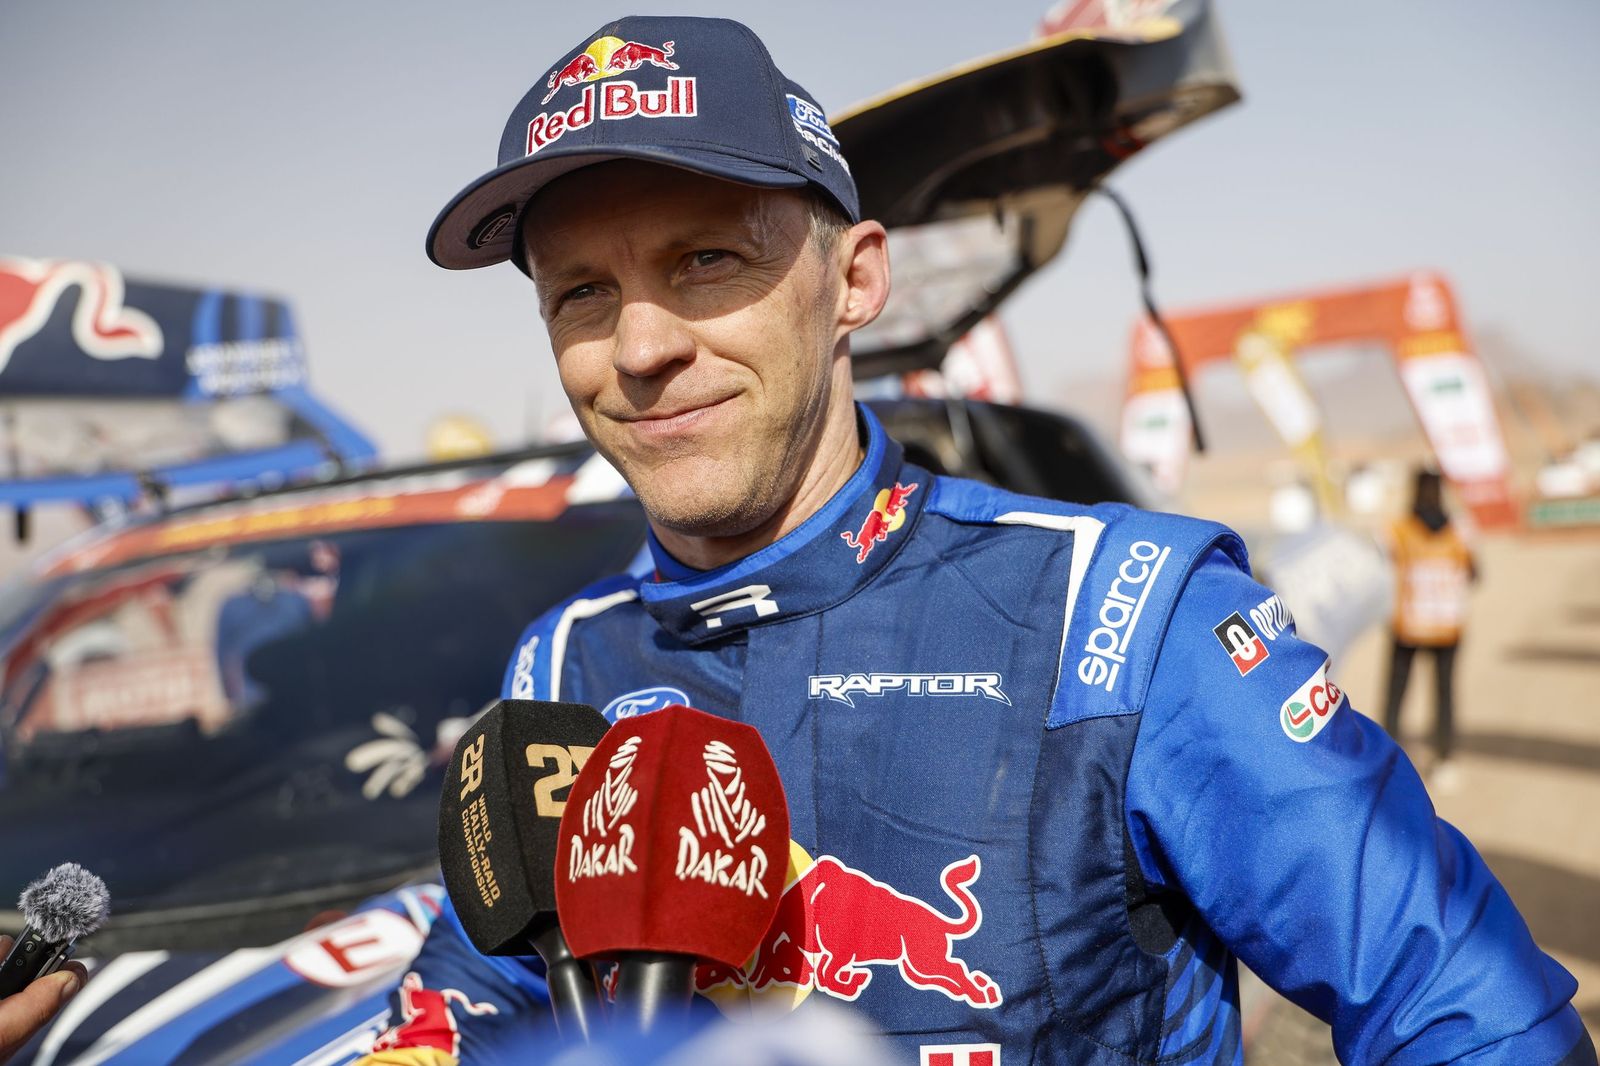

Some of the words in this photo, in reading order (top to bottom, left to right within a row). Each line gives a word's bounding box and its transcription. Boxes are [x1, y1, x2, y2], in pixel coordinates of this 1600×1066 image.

[526, 86, 595, 156] Red
[601, 77, 697, 120] Bull
[1078, 541, 1171, 692] sparco
[808, 672, 1012, 708] RAPTOR
[1309, 682, 1341, 717] Ca
[469, 800, 500, 900] RALLY-RAID
[478, 793, 492, 843] WORLD
[569, 823, 638, 883] DAKAR
[462, 809, 494, 908] CHAMPIONSHIP
[675, 826, 769, 899] DAKAR
